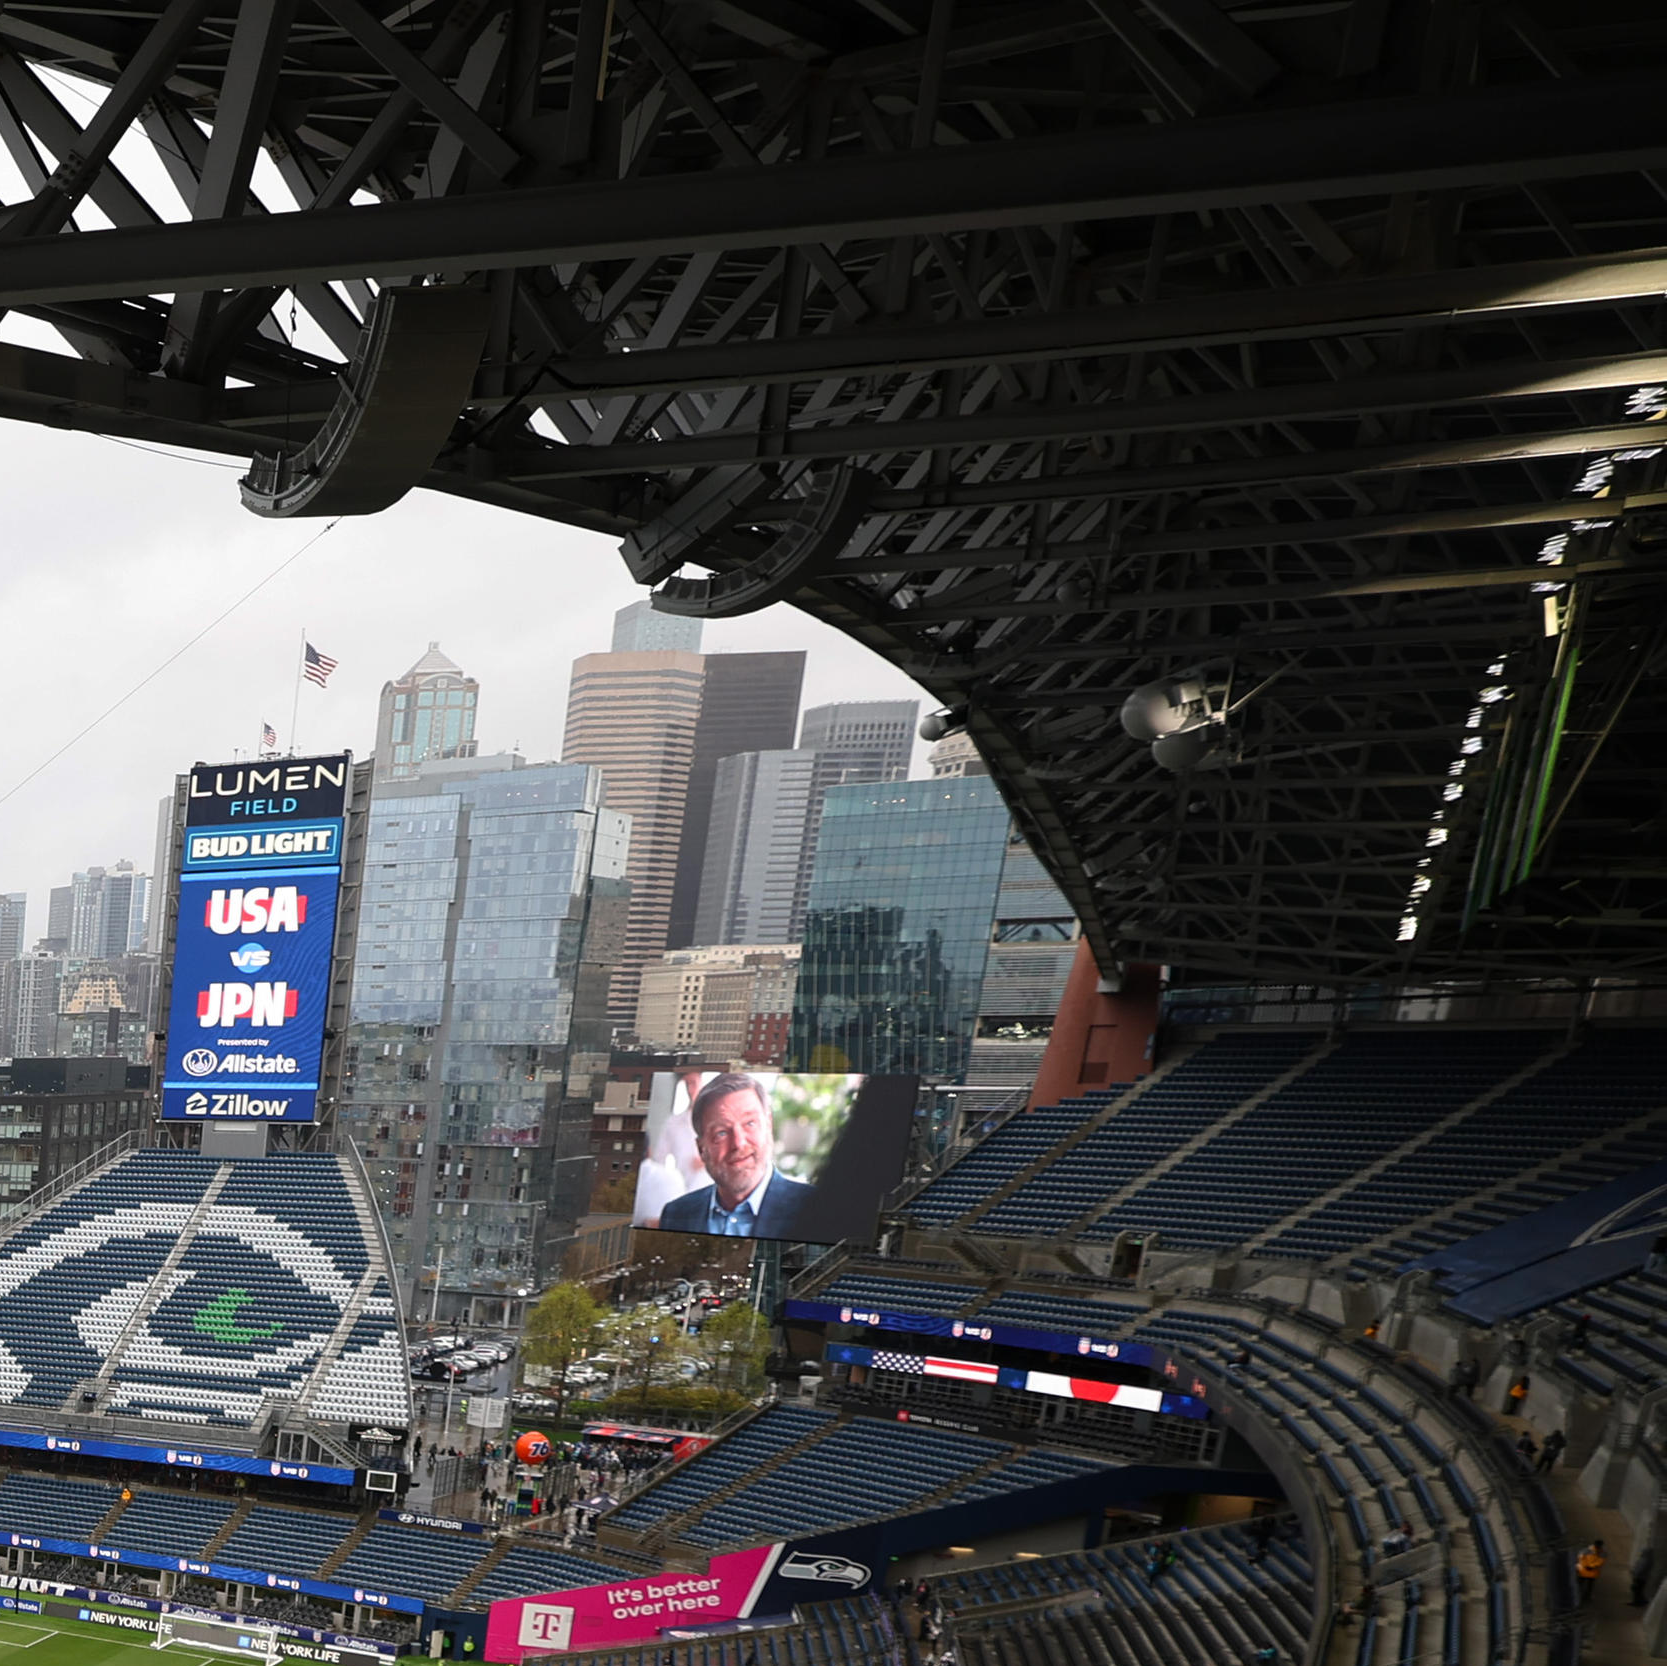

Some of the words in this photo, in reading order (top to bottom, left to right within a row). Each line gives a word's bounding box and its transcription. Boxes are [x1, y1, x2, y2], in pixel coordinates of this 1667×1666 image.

[190, 763, 345, 797] LUMEN
[231, 798, 297, 816] FIELD
[192, 835, 248, 858] BUD
[250, 830, 331, 855] LIGHT
[209, 886, 298, 935] USA
[200, 982, 287, 1027] JPN
[217, 1038, 257, 1046] Presented
[258, 1038, 269, 1046] by
[210, 1094, 288, 1116] Zillow
[529, 1441, 549, 1457] 76
[416, 1516, 463, 1531] HYUNDAI
[607, 1587, 643, 1605] It's
[646, 1578, 721, 1600] better
[612, 1601, 664, 1619] over
[668, 1594, 720, 1613] here
[90, 1611, 117, 1624] NEW
[118, 1615, 147, 1630] YORK
[148, 1620, 173, 1634] LIFE
[532, 1611, 561, 1641] T
[251, 1637, 279, 1651] NEW
[280, 1642, 315, 1658] YORK
[316, 1649, 341, 1663] LIFE
